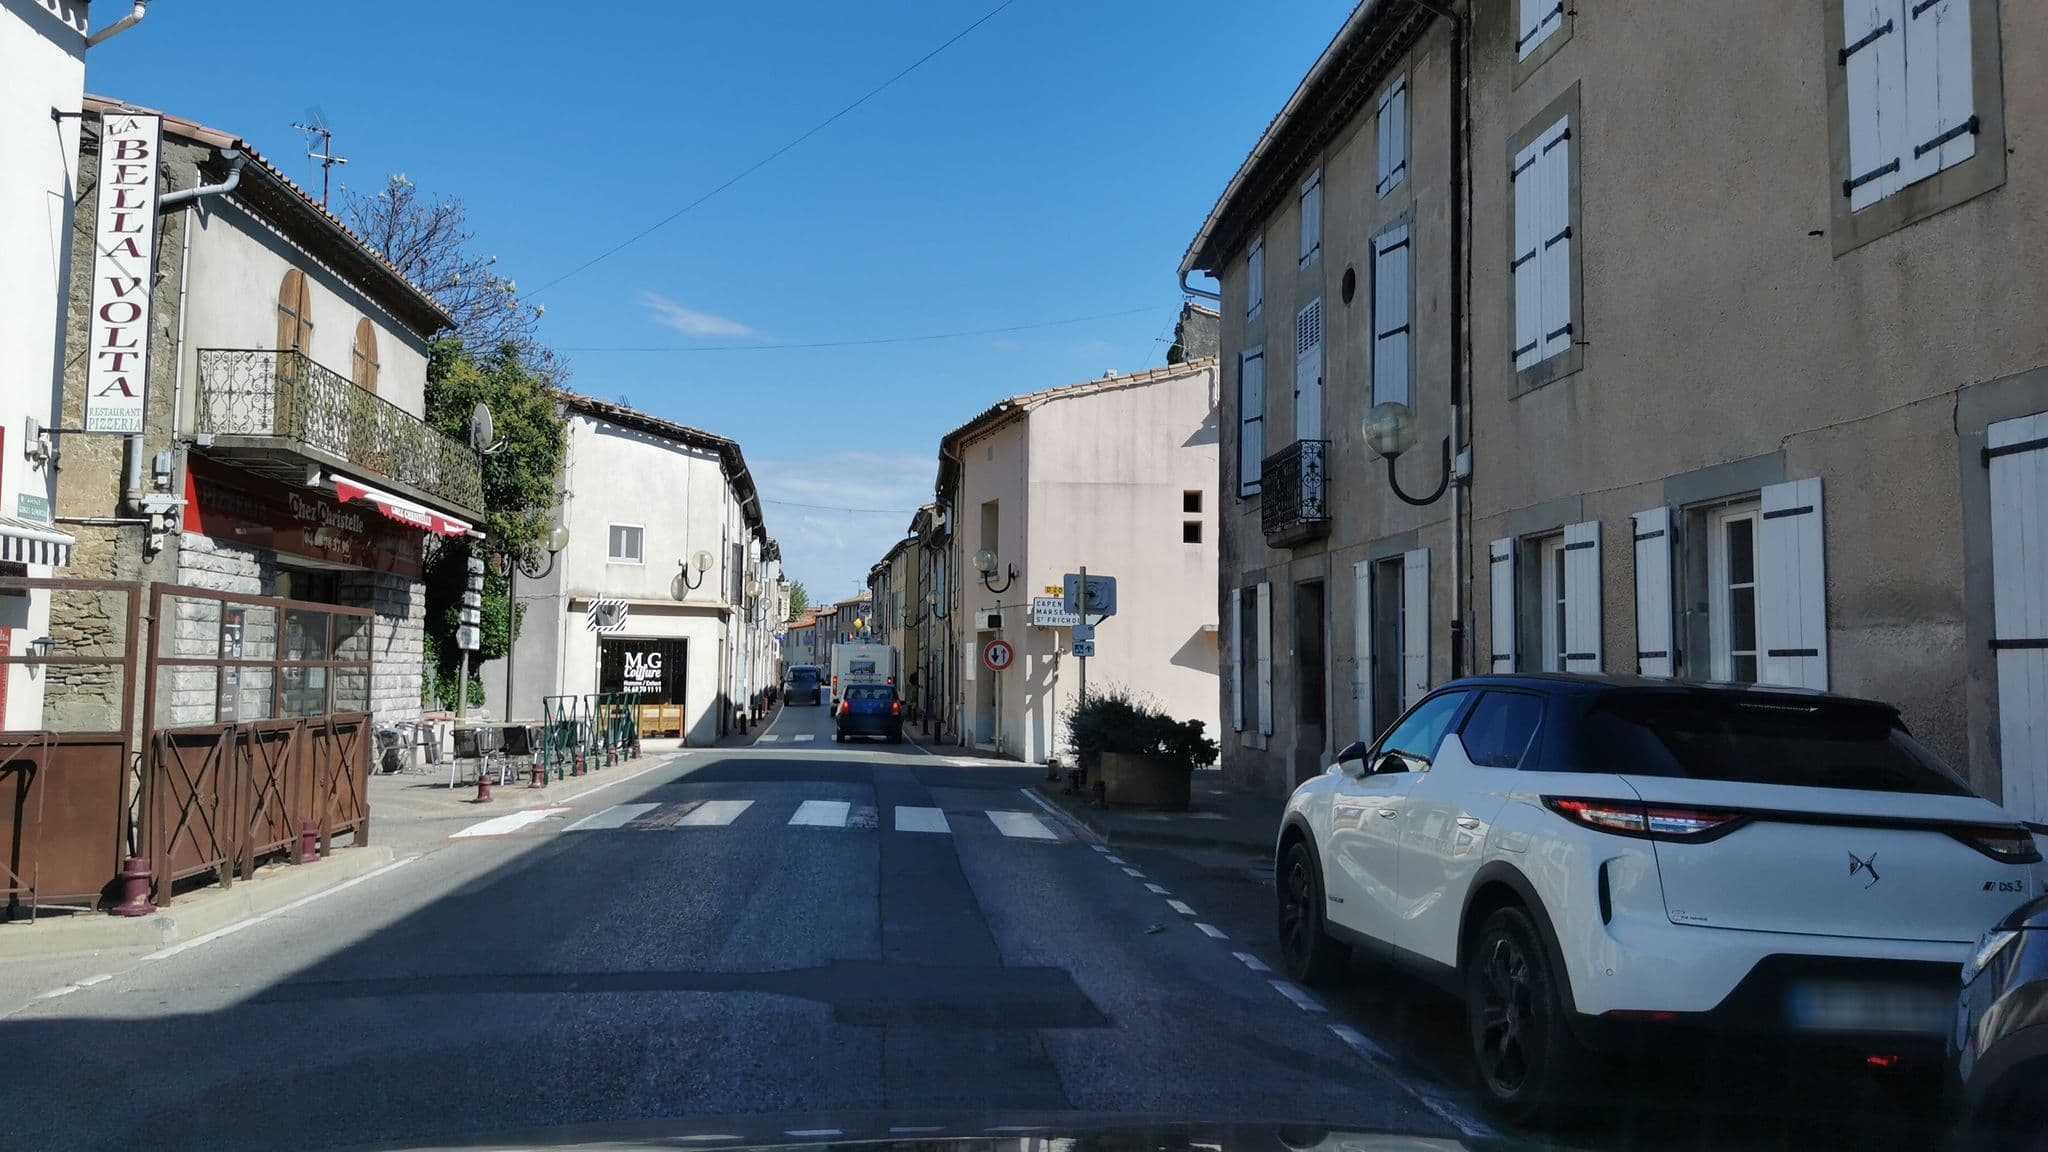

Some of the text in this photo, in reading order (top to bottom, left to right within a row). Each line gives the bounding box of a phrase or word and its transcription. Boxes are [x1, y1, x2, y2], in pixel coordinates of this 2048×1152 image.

[106, 119, 141, 136] LA
[94, 138, 150, 398] BELLA VOLTA
[89, 407, 142, 417] RESTAURANT
[88, 417, 142, 431] PIZZERIA
[289, 492, 317, 520] Chez
[317, 500, 364, 534] Christelle
[1036, 600, 1062, 608] CAPEN
[1047, 616, 1081, 624] FRICHOU
